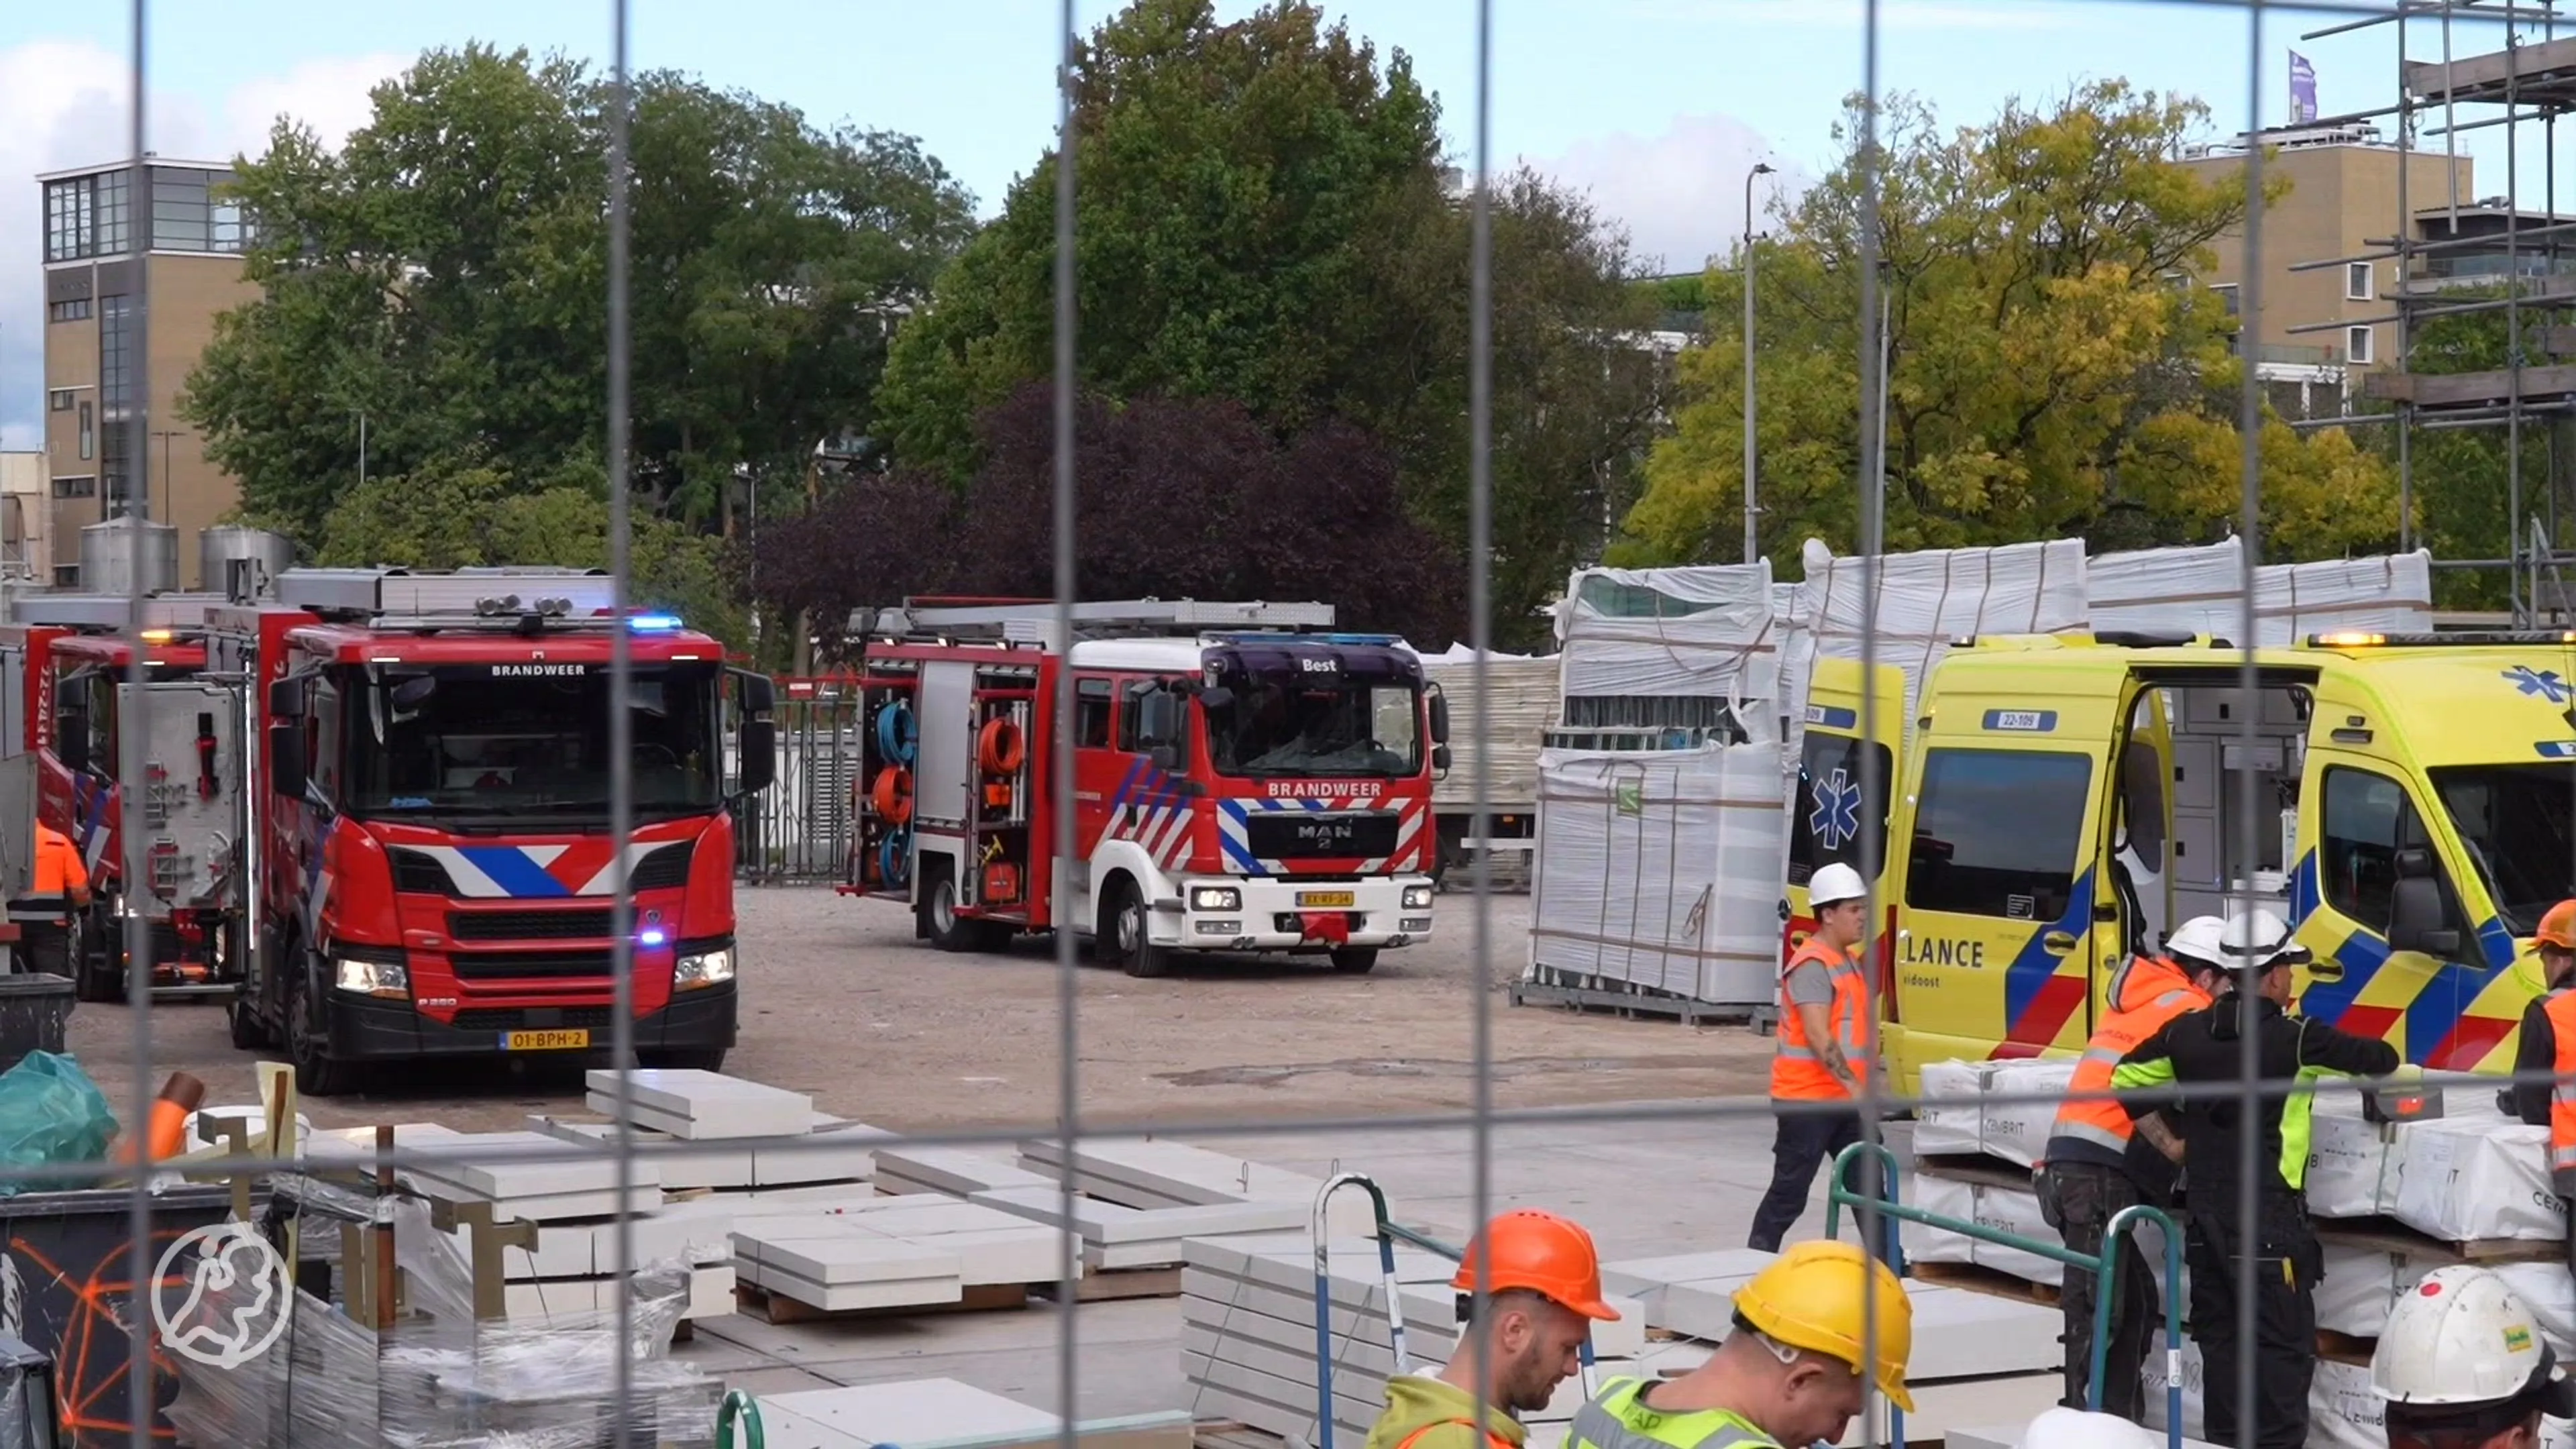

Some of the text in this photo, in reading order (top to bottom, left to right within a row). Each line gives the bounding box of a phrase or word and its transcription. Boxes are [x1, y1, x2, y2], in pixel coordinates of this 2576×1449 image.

[492, 665, 585, 676] BRANDWEER
[1301, 658, 1337, 672] Best
[1268, 782, 1381, 796] BRANDWEER
[1298, 825, 1352, 838] MAN
[1907, 936, 1983, 968] LANCE
[514, 1033, 582, 1047] 01-BPH-2
